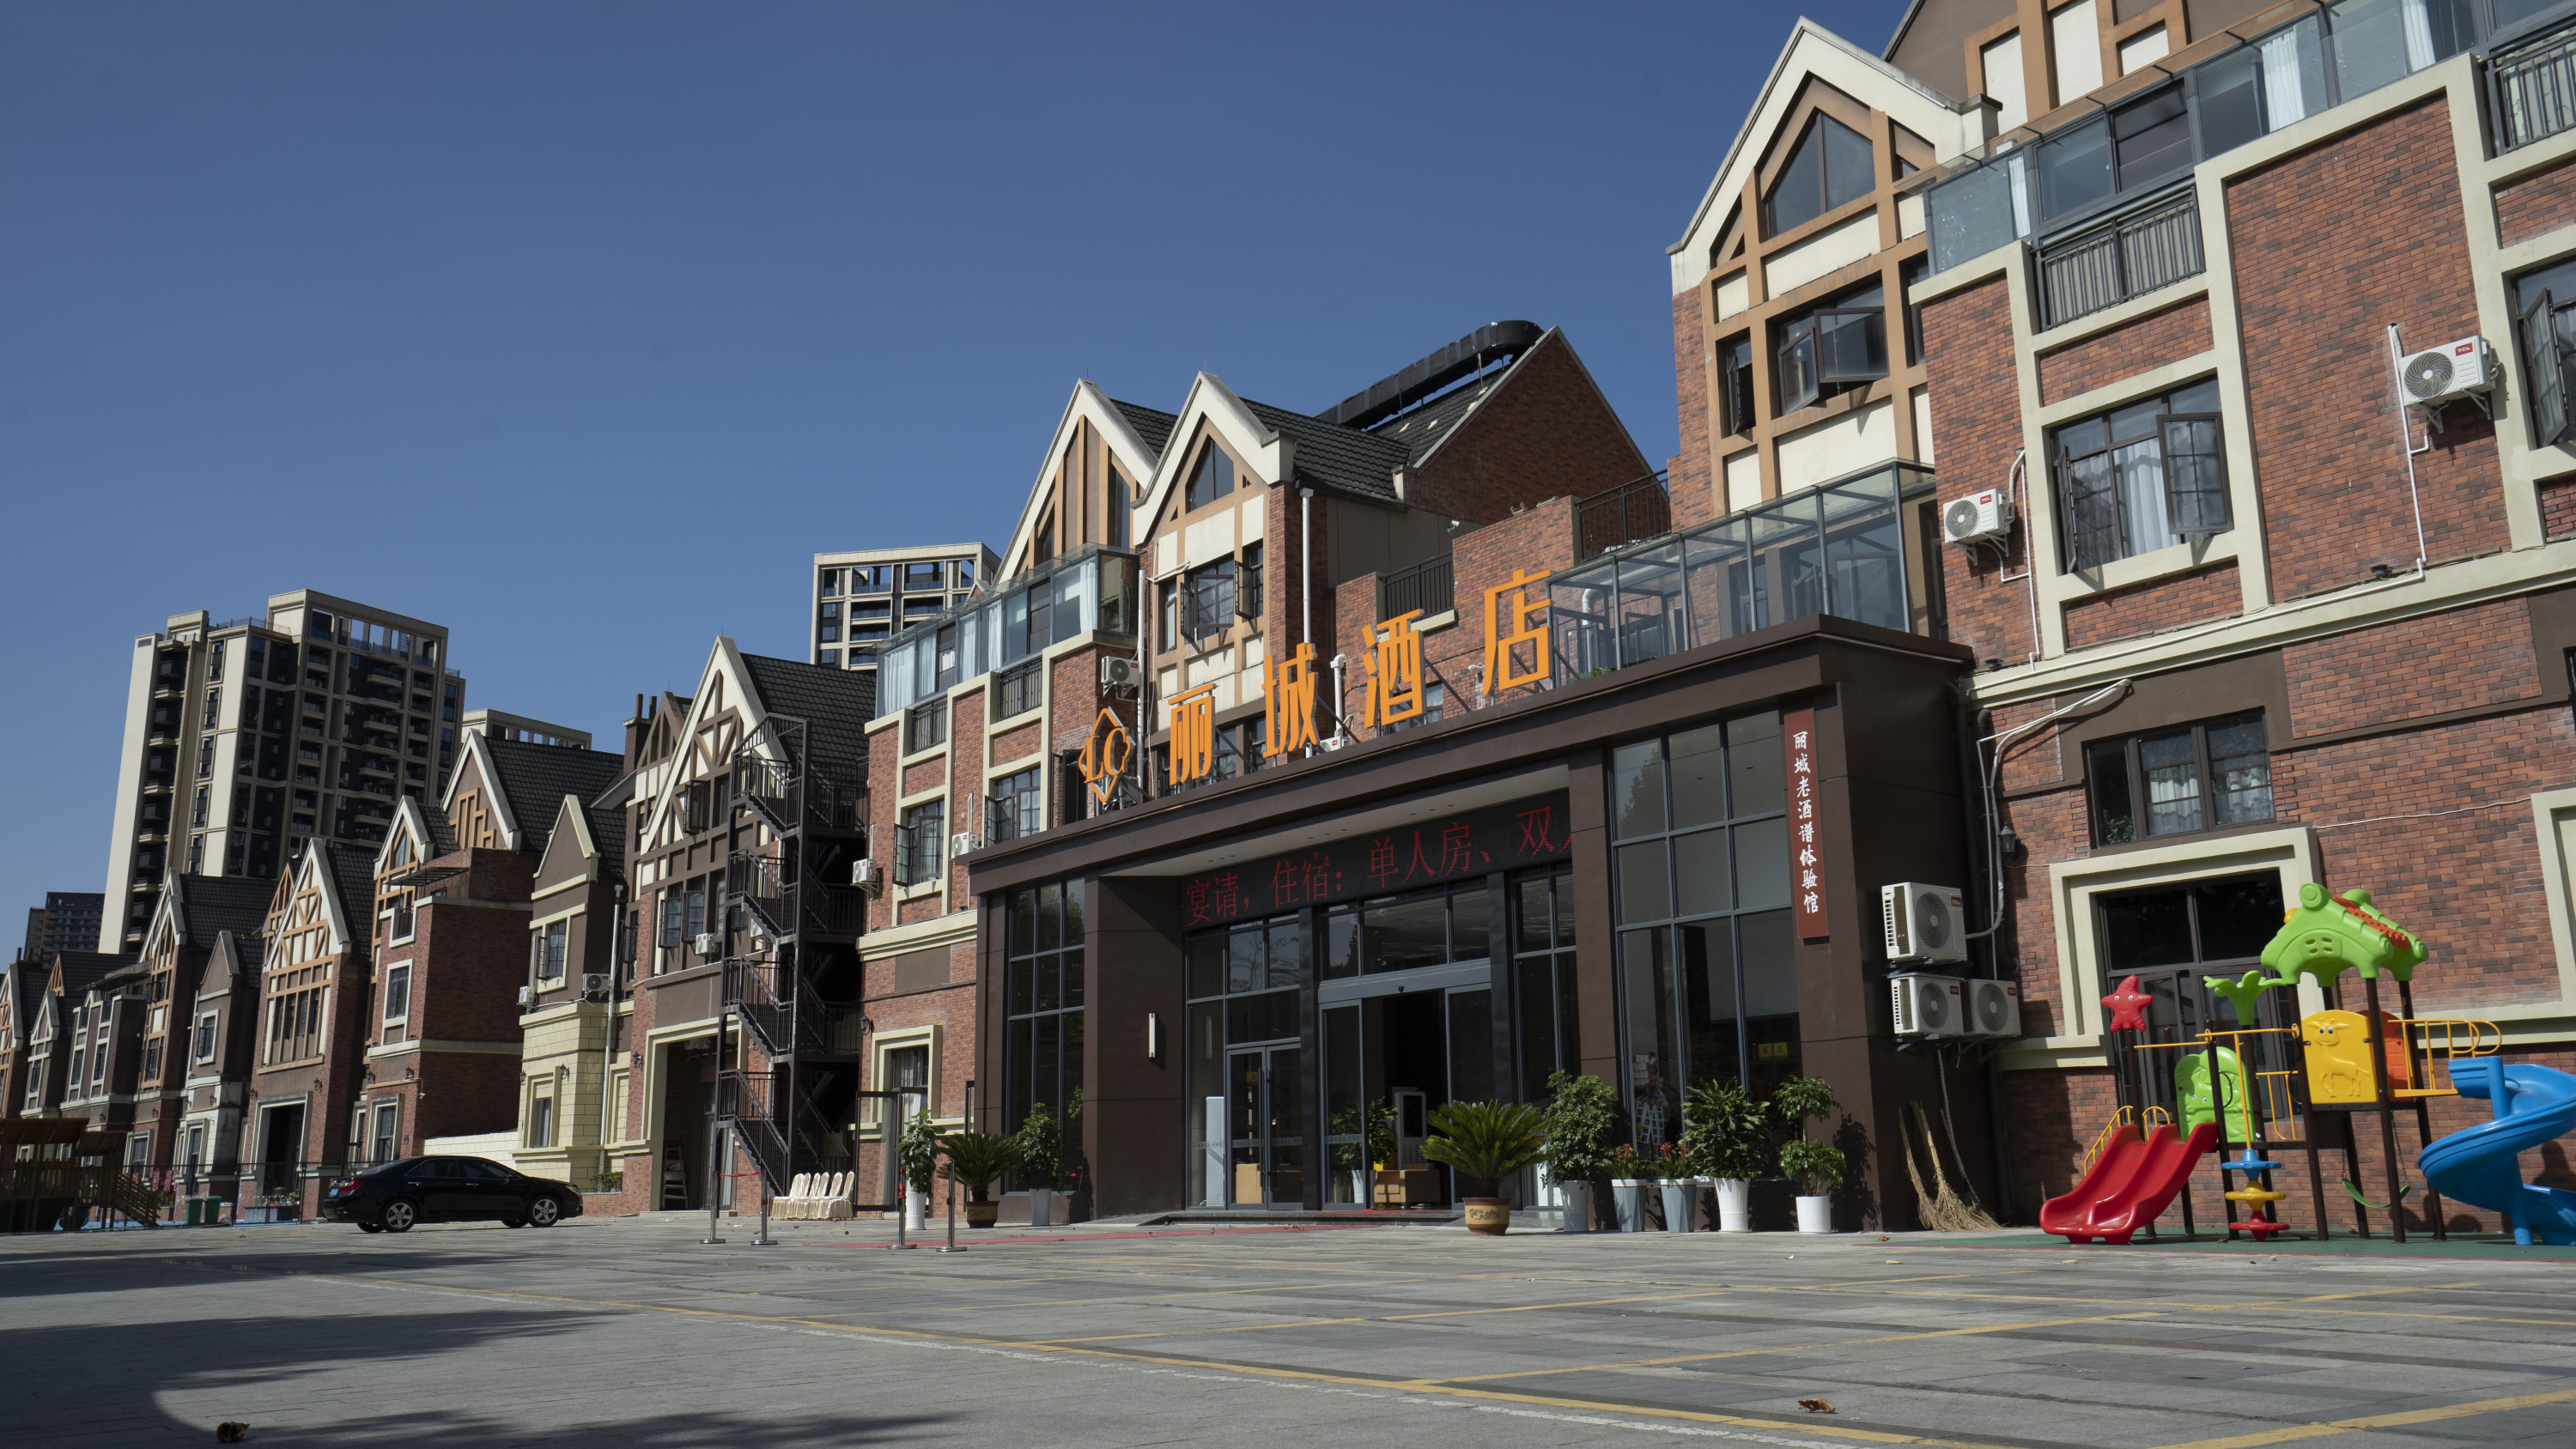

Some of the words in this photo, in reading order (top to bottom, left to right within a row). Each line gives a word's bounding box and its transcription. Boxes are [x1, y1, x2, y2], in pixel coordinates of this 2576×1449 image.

[1084, 727, 1127, 784] LC
[1169, 567, 1552, 785] 丽城酒店
[1793, 731, 1819, 914] 丽城老酒谱体验馆
